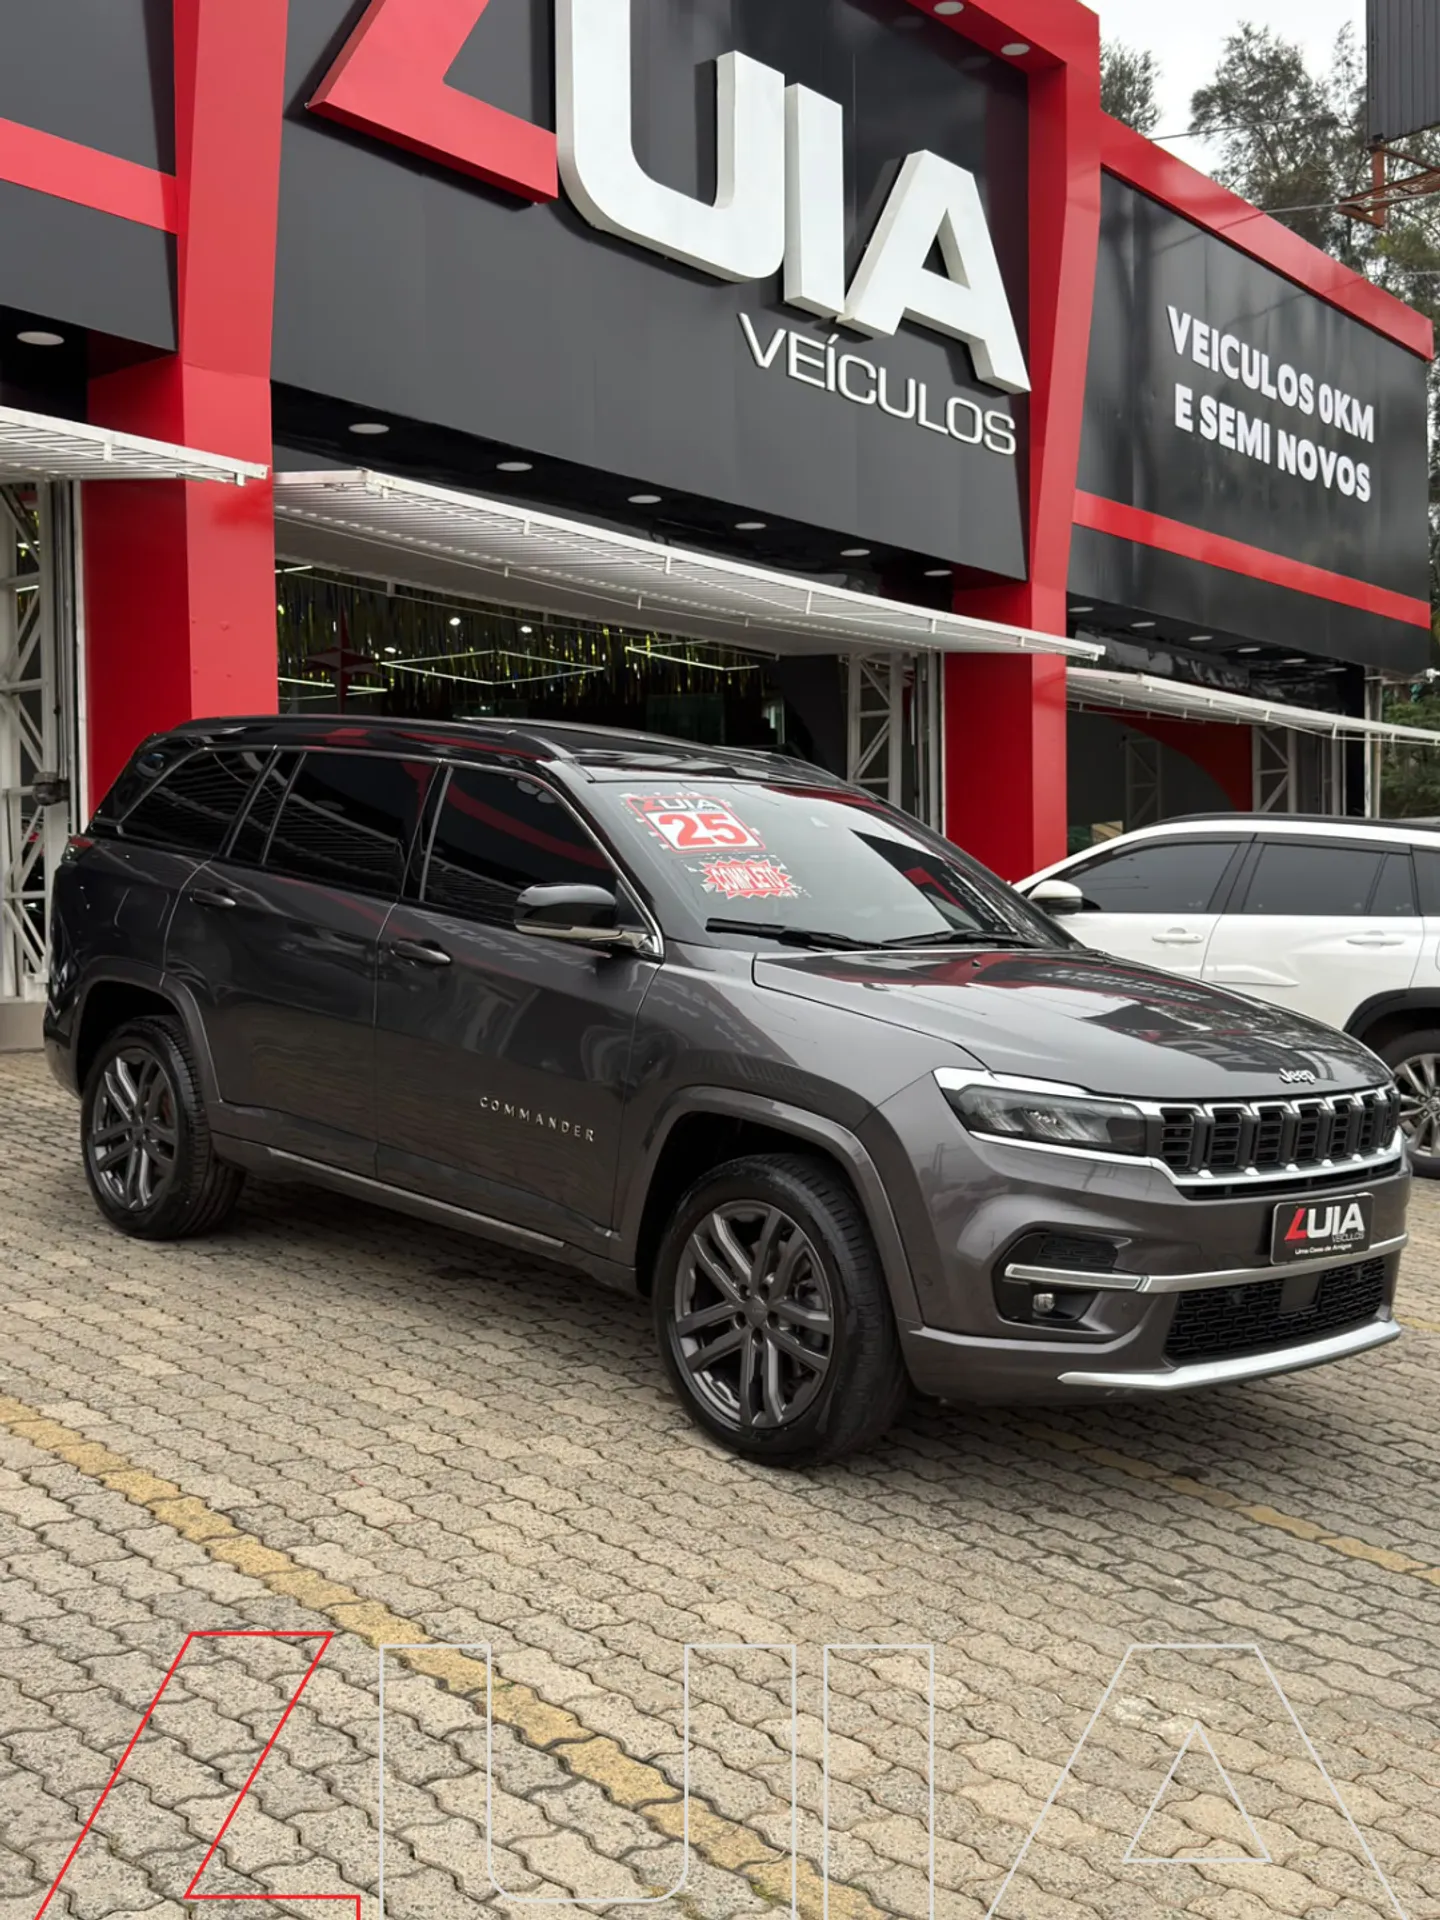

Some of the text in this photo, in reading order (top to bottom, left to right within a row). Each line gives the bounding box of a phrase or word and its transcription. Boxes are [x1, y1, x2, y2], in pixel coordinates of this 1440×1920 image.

[1167, 305, 1314, 415] VEICULOS
[738, 312, 1017, 455] VEÍCULOS
[1175, 383, 1371, 502] E SEMI NOVOS
[658, 813, 748, 847] 25
[710, 865, 785, 891] COMPLETO
[1279, 1068, 1316, 1084] Jeep
[479, 1096, 595, 1142] COMMANDER
[1284, 1202, 1365, 1241] LUIA
